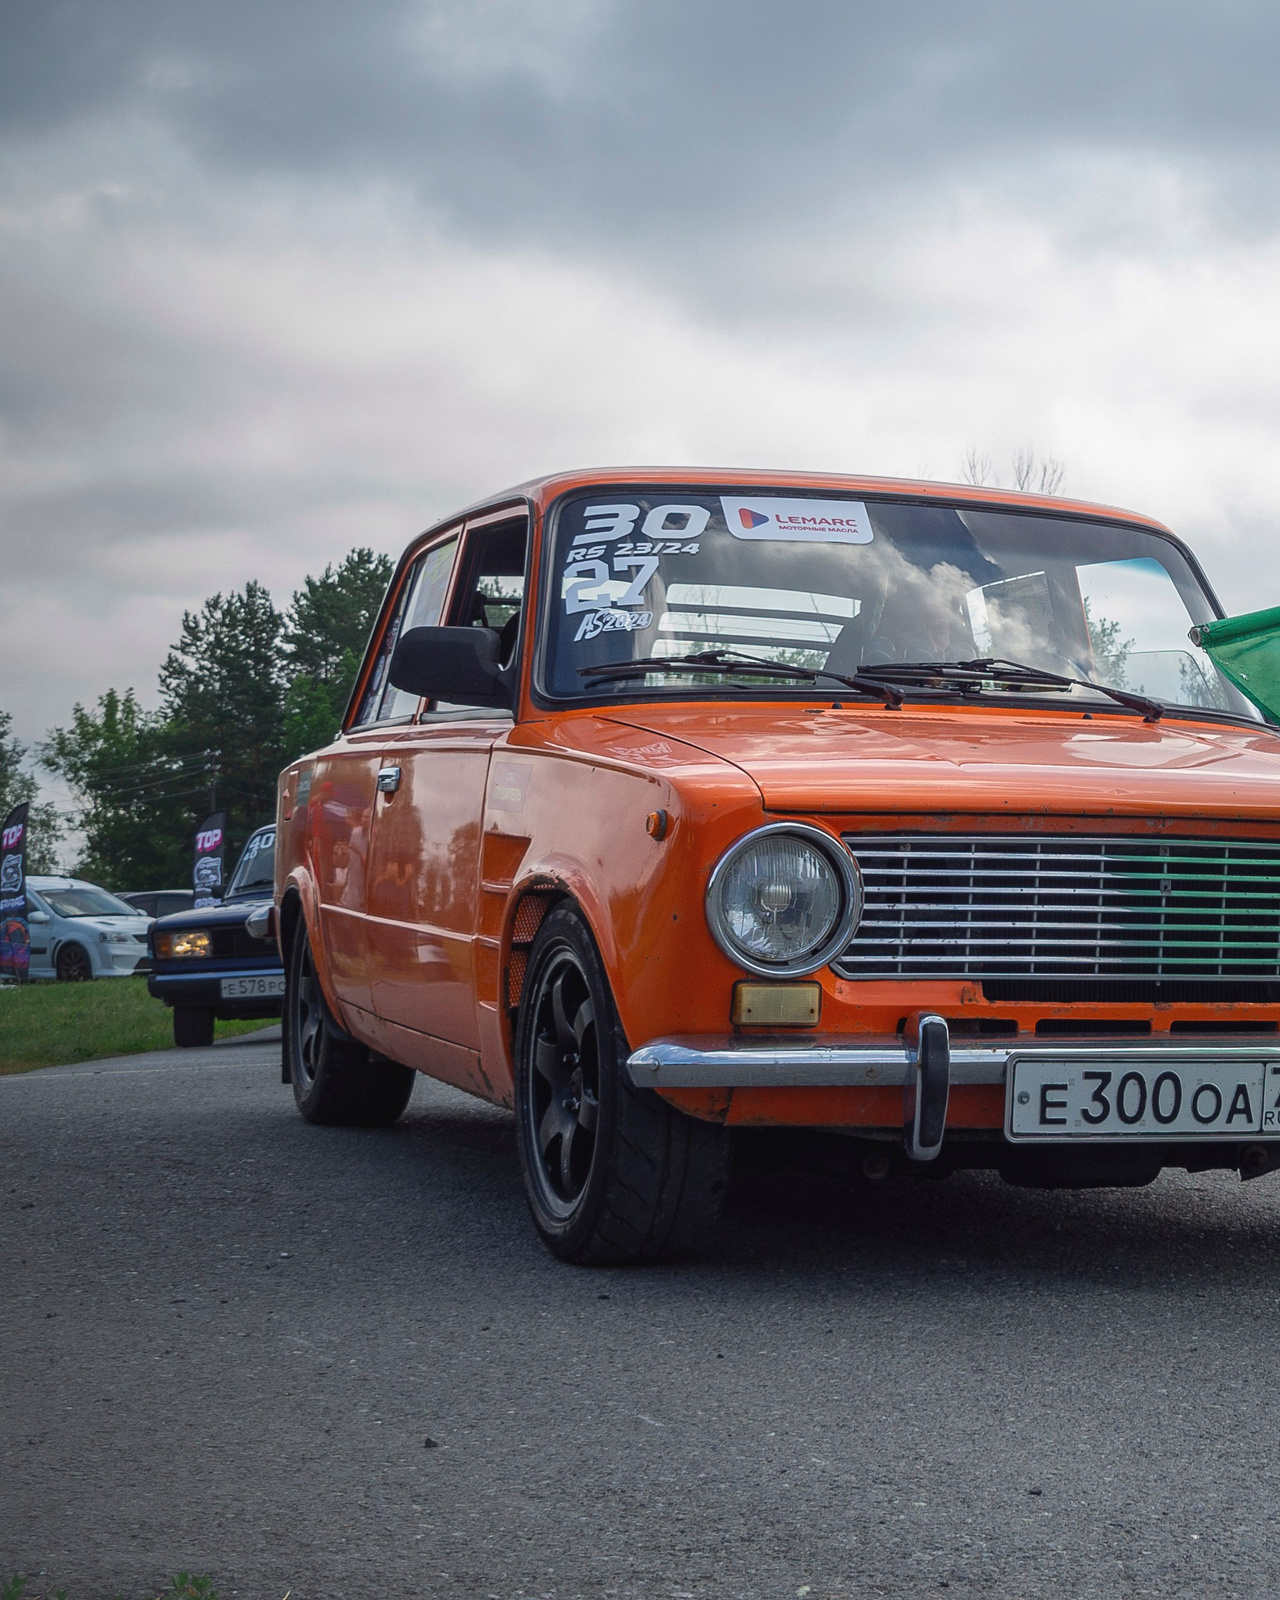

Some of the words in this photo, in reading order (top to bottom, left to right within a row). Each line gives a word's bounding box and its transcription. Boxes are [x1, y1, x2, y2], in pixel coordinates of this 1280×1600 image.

[572, 504, 711, 546] 30
[775, 514, 858, 527] LEMARC
[566, 545, 607, 563] RS
[614, 542, 700, 555] 23/24
[563, 555, 660, 615] 27
[2, 824, 23, 848] TOP
[196, 829, 222, 850] TOP
[1039, 1070, 1254, 1126] E300OA
